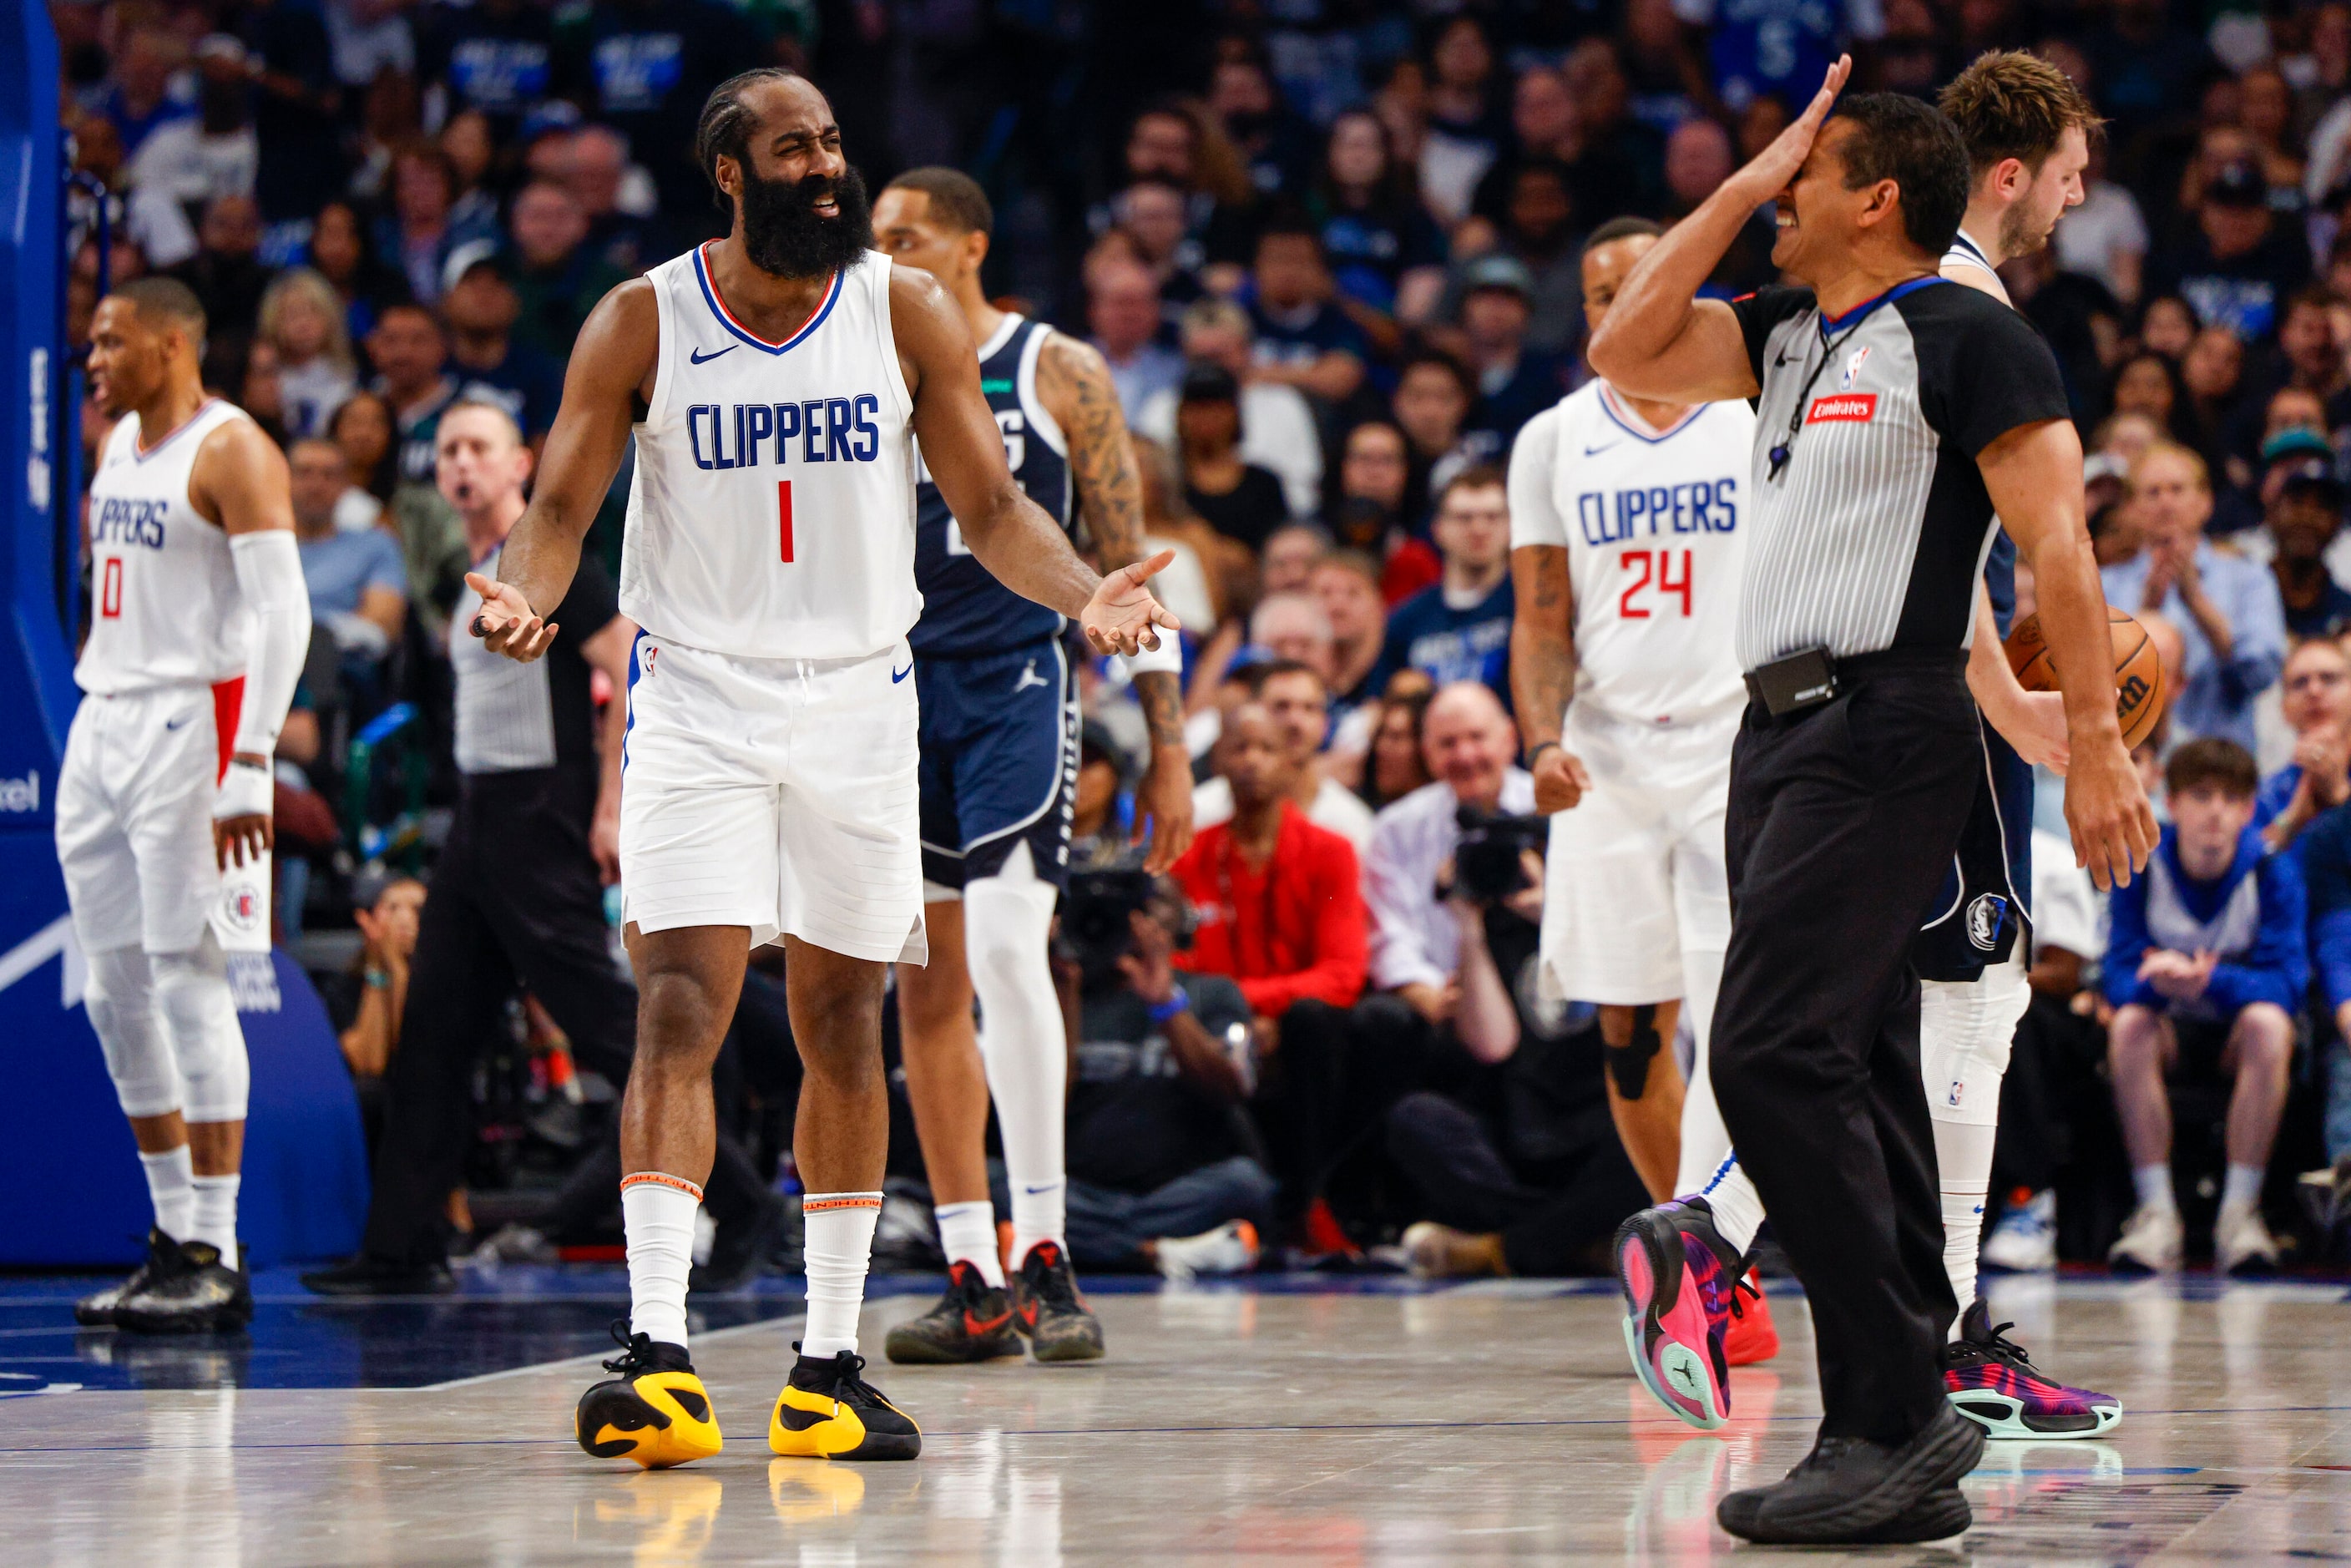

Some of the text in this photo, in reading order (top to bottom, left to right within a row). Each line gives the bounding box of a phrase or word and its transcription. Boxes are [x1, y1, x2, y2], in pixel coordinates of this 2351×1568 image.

[686, 393, 880, 470] CLIPPERS
[1813, 399, 1869, 419] Emirates
[778, 479, 795, 564] 1
[1578, 477, 1737, 547] CLIPPERS
[102, 557, 123, 619] 0
[1620, 548, 1692, 619] 24
